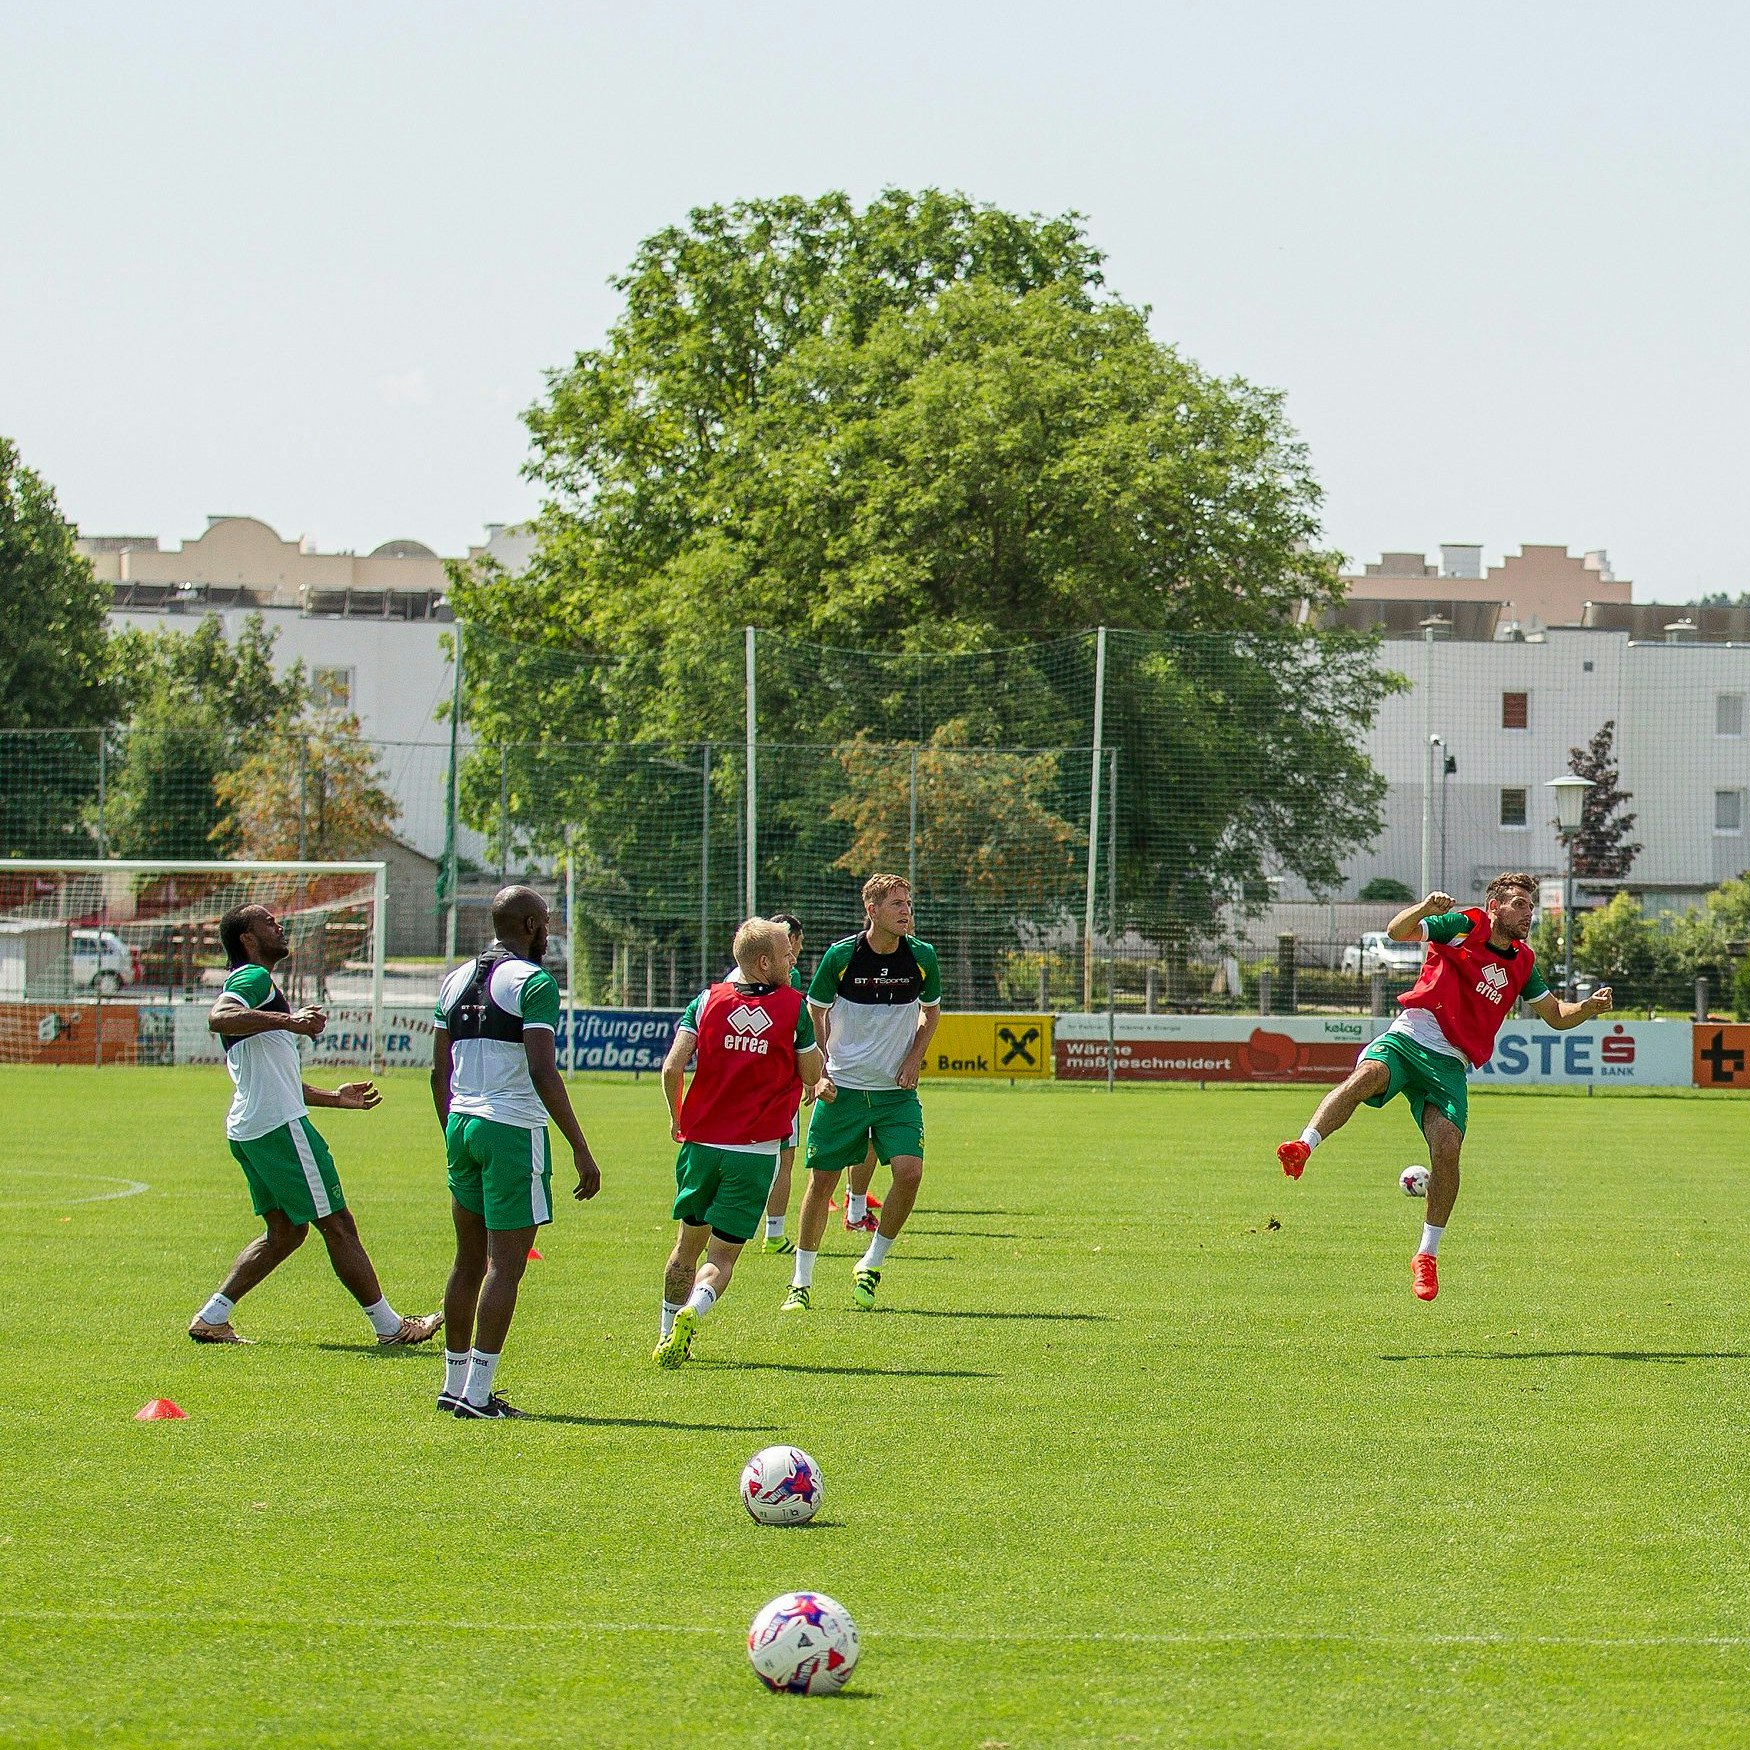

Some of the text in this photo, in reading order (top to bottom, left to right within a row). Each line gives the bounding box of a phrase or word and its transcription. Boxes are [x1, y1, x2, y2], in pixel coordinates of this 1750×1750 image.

[880, 968, 888, 976] 3
[556, 1014, 669, 1043] hriftungen
[1325, 1022, 1362, 1034] kelag
[314, 1033, 411, 1051] PRENER
[938, 1055, 988, 1071] Bank
[1601, 1068, 1634, 1076] BANK
